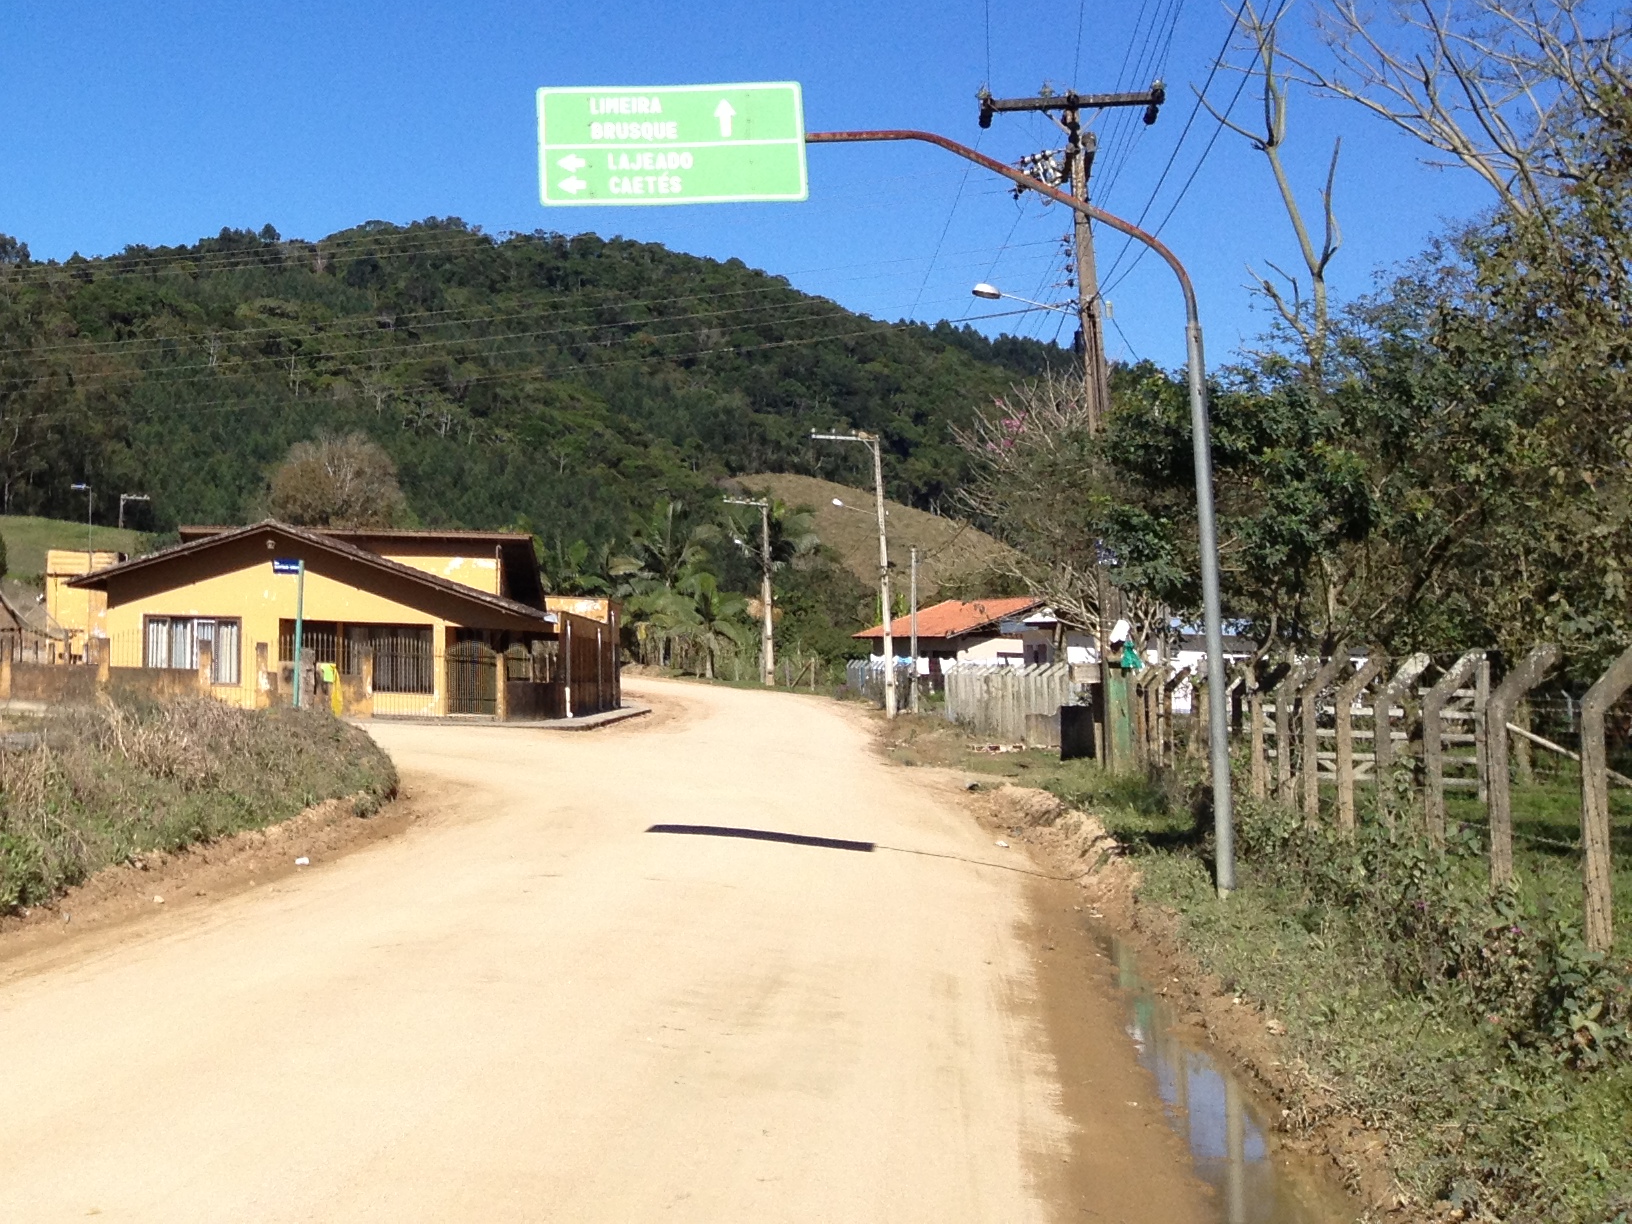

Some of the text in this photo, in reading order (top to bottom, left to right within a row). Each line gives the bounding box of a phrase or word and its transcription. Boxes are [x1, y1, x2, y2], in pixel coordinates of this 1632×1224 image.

[589, 96, 662, 114] LIMEIRA
[590, 121, 678, 142] BRUSQUE
[607, 151, 694, 170] LAJEADO
[609, 171, 682, 194] CAETÉS
